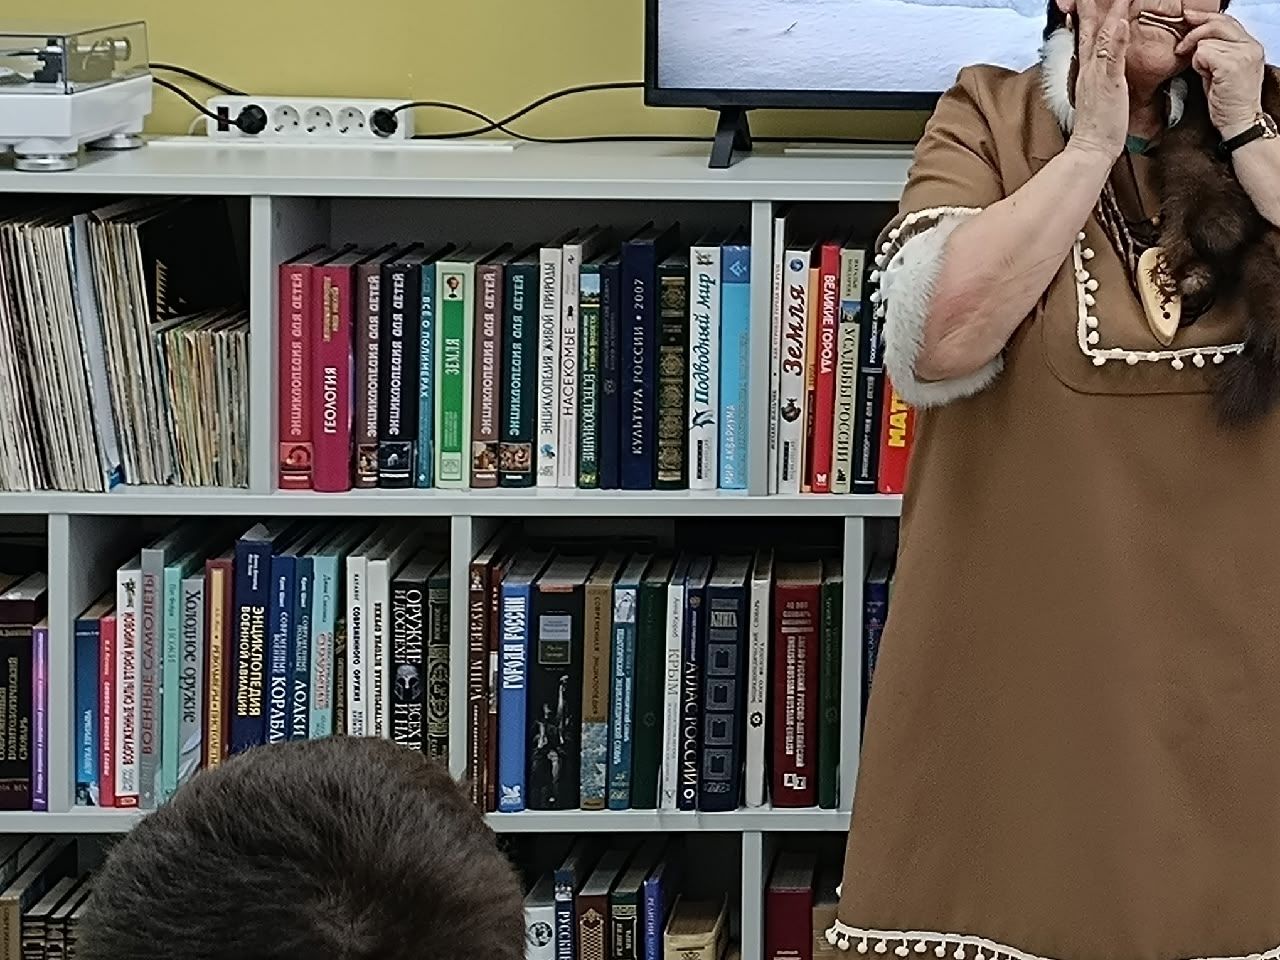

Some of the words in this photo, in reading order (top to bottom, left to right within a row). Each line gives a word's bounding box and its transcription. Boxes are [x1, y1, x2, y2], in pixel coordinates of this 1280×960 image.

[290, 273, 302, 309] ДЕТЕЙ
[392, 273, 404, 309] ДЕТЕЙ
[422, 297, 432, 316] ВСЁ
[484, 273, 495, 309] ДЕТЕЙ
[511, 275, 523, 311] ДЕТЕЙ
[543, 263, 556, 309] ПРИРОДЫ
[634, 279, 644, 309] 2007
[698, 273, 715, 309] мир
[822, 275, 836, 325] ВЕЛИКИЕ
[422, 320, 430, 328] О
[540, 315, 554, 351] ЖИВОЙ
[784, 285, 805, 376] Земля
[820, 328, 834, 373] ГОРОДА
[420, 332, 430, 398] ПОЛИМЕРАХ
[444, 338, 460, 375] ЗЕМЛЯ
[564, 328, 575, 416] НАСЕКОМЫЕ
[633, 327, 644, 383] РОССИИ
[693, 314, 710, 405] Подводный
[839, 328, 856, 398] УСАДЬБЫ
[290, 342, 302, 435] ЭНЦИКЛОПЕДИЯ
[324, 367, 337, 433] ГЕОЛОГИЯ
[388, 341, 401, 435] ЭНЦИКЛОПЕДИЯ
[481, 341, 494, 435] ЭНЦИКЛОПЕДИЯ
[510, 343, 522, 435] ЭНЦИКЛОПЕДИЯ
[541, 356, 554, 434] ЭНЦИКЛОПЕДИЯ
[582, 374, 595, 462] ЕСТЕСТВОЗНАНИЕ
[633, 389, 643, 454] КУЛЬТУРА
[726, 404, 736, 461] АКВАРИУМА
[837, 402, 854, 462] РОССИИ
[725, 463, 736, 484] МИР
[142, 574, 154, 670] САМОЛЕТЫ
[394, 590, 405, 599] И
[504, 597, 525, 640] РОССИИ
[122, 612, 135, 648] МИРОВОЙ
[183, 590, 201, 662] Холодное
[240, 606, 250, 659] ВОЕННОЙ
[393, 602, 406, 664] ДОСПЕХИ
[405, 590, 422, 664] ОРУЖИЕ
[123, 651, 135, 680] ВТОРОЙ
[237, 661, 249, 716] АВИАЦИИ
[249, 606, 264, 716] ЭНЦИКЛОПЕДИЯ
[470, 660, 483, 701] МИРА
[503, 644, 525, 689] ГОРОДА
[667, 648, 679, 695] КРЫМ
[684, 661, 697, 713] АТЛАС
[786, 636, 794, 694] ENGLISH-RUSSIAN
[123, 683, 135, 703] СИЛЫ
[142, 675, 153, 754] ВОЕННЫЕ
[178, 667, 196, 722] оружие
[293, 680, 306, 735] ЛОДКИ
[394, 704, 406, 714] И
[407, 703, 422, 737] ВСЕХ
[121, 706, 134, 765] ВООРУЖЕННЫЕ
[684, 718, 697, 785] РОССИИ
